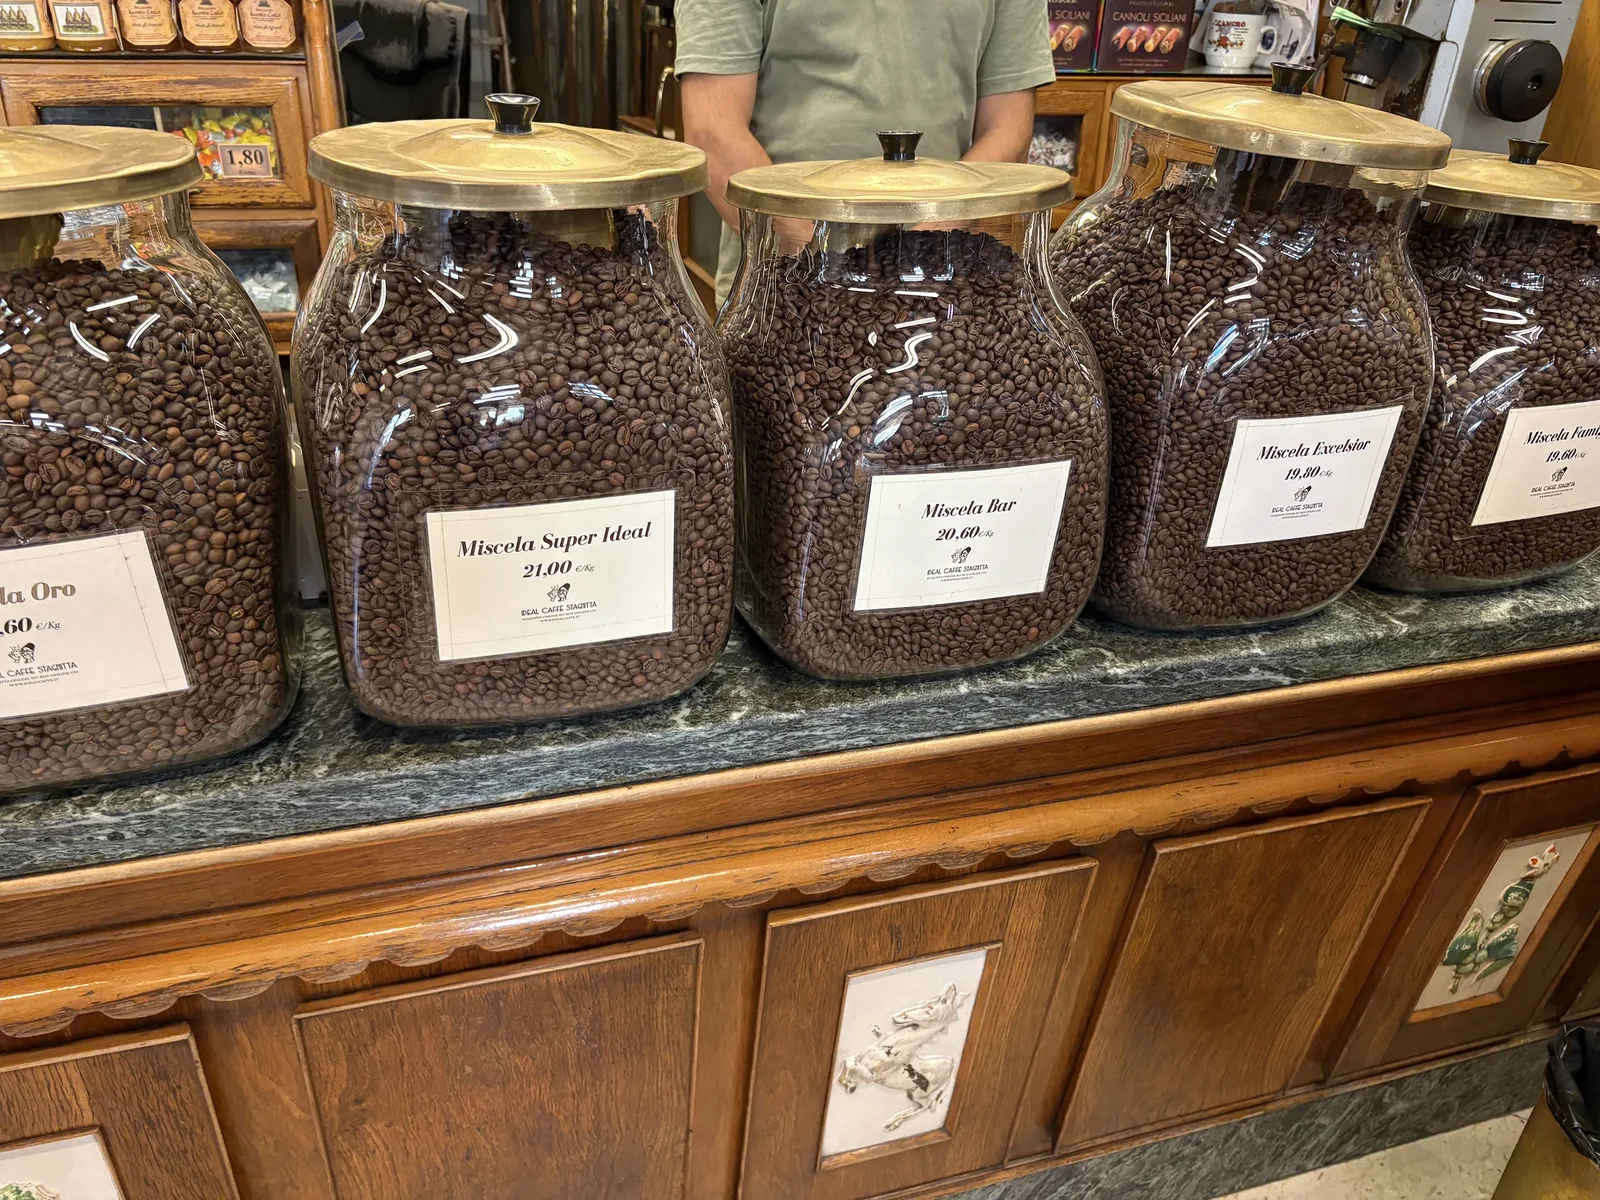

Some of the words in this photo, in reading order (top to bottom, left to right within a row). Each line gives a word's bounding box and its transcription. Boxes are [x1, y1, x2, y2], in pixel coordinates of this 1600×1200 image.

[1055, 10, 1091, 20] SICILIANI
[1112, 12, 1150, 22] CANNOLI
[1152, 12, 1187, 22] SICILIANI
[227, 149, 264, 168] 1,80
[1523, 429, 1570, 445] Miscela
[1256, 443, 1310, 461] Miscela
[1312, 438, 1371, 457] Excelsior
[1545, 448, 1576, 463] 19,60
[1284, 465, 1320, 481] 19,80
[922, 500, 983, 519] Miscela
[986, 497, 1017, 514] Bar
[456, 535, 536, 558] Miscela
[540, 532, 598, 553] Super
[602, 521, 652, 543] Ideal
[935, 526, 980, 542] 20,60
[522, 559, 573, 579] 21,00
[926, 568, 941, 576] IDEAL
[30, 581, 76, 601] Oro
[521, 608, 540, 616] IDEAL
[35, 620, 61, 631] €/Kg
[6, 668, 35, 678] CAFFE
